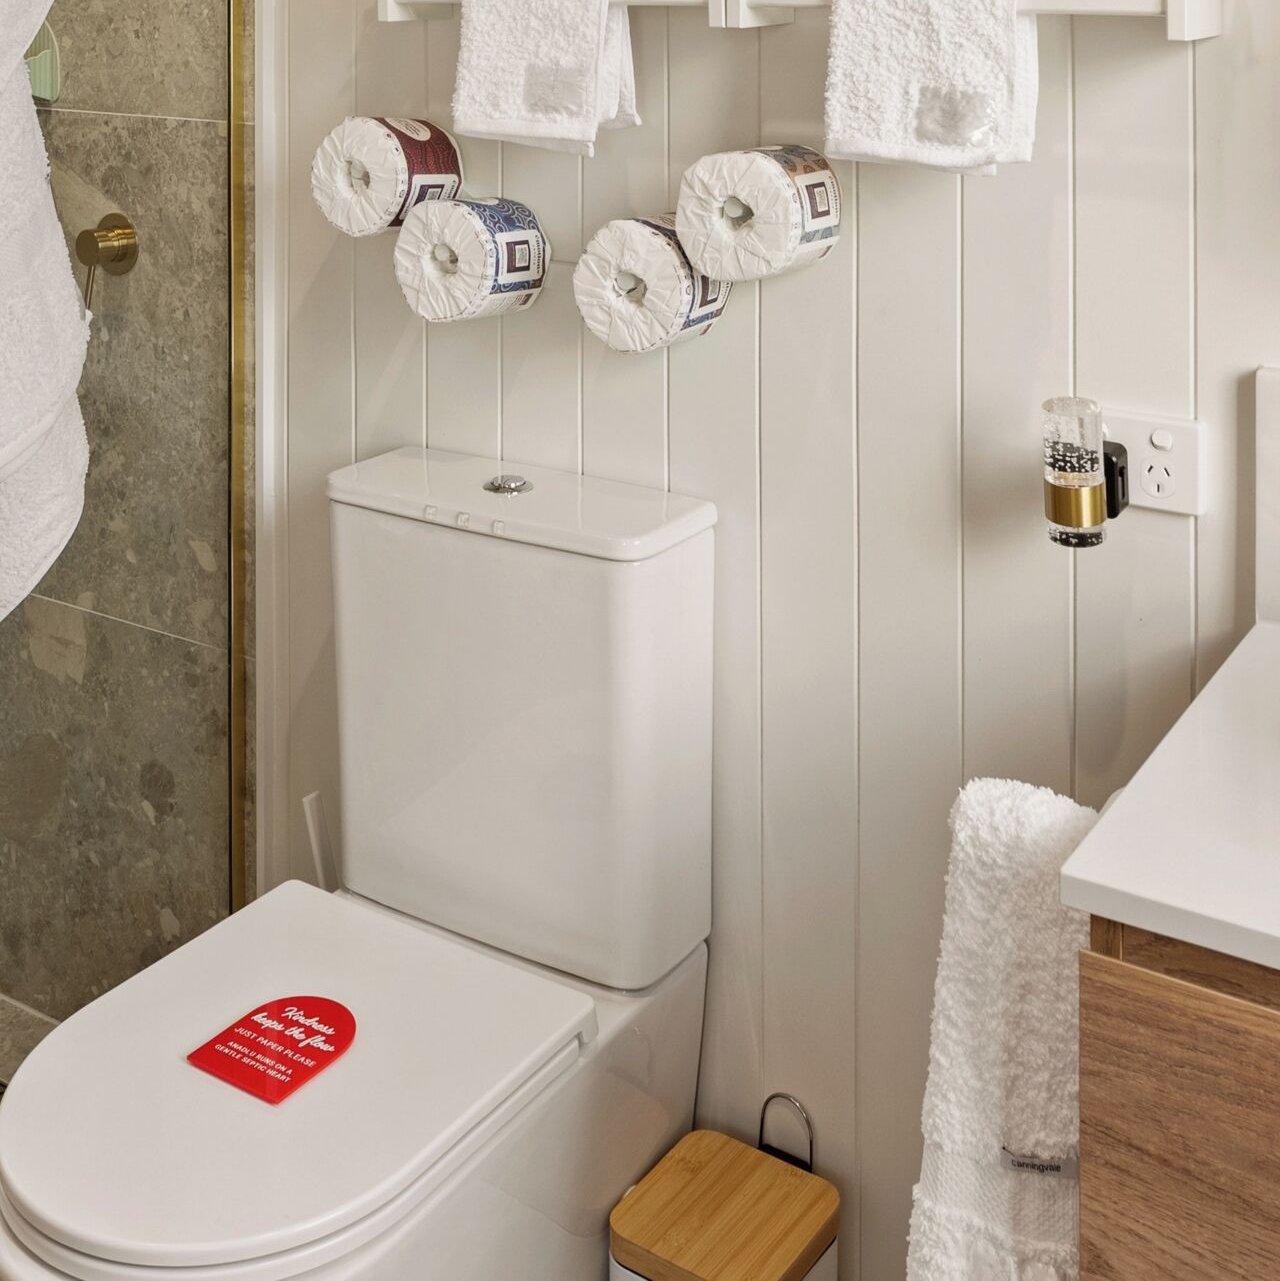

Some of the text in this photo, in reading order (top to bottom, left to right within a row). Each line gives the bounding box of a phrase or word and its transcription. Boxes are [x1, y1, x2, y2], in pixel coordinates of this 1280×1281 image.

[250, 1012, 337, 1052] keeps the flow
[281, 1006, 336, 1035] Kindness
[214, 1043, 292, 1083] GENTLE SEPTIC HEART
[227, 1041, 256, 1057] ANADLU
[255, 1054, 275, 1068] RUNS
[274, 1062, 287, 1072] ON
[234, 1026, 317, 1068] JUST PAPER PLEASE
